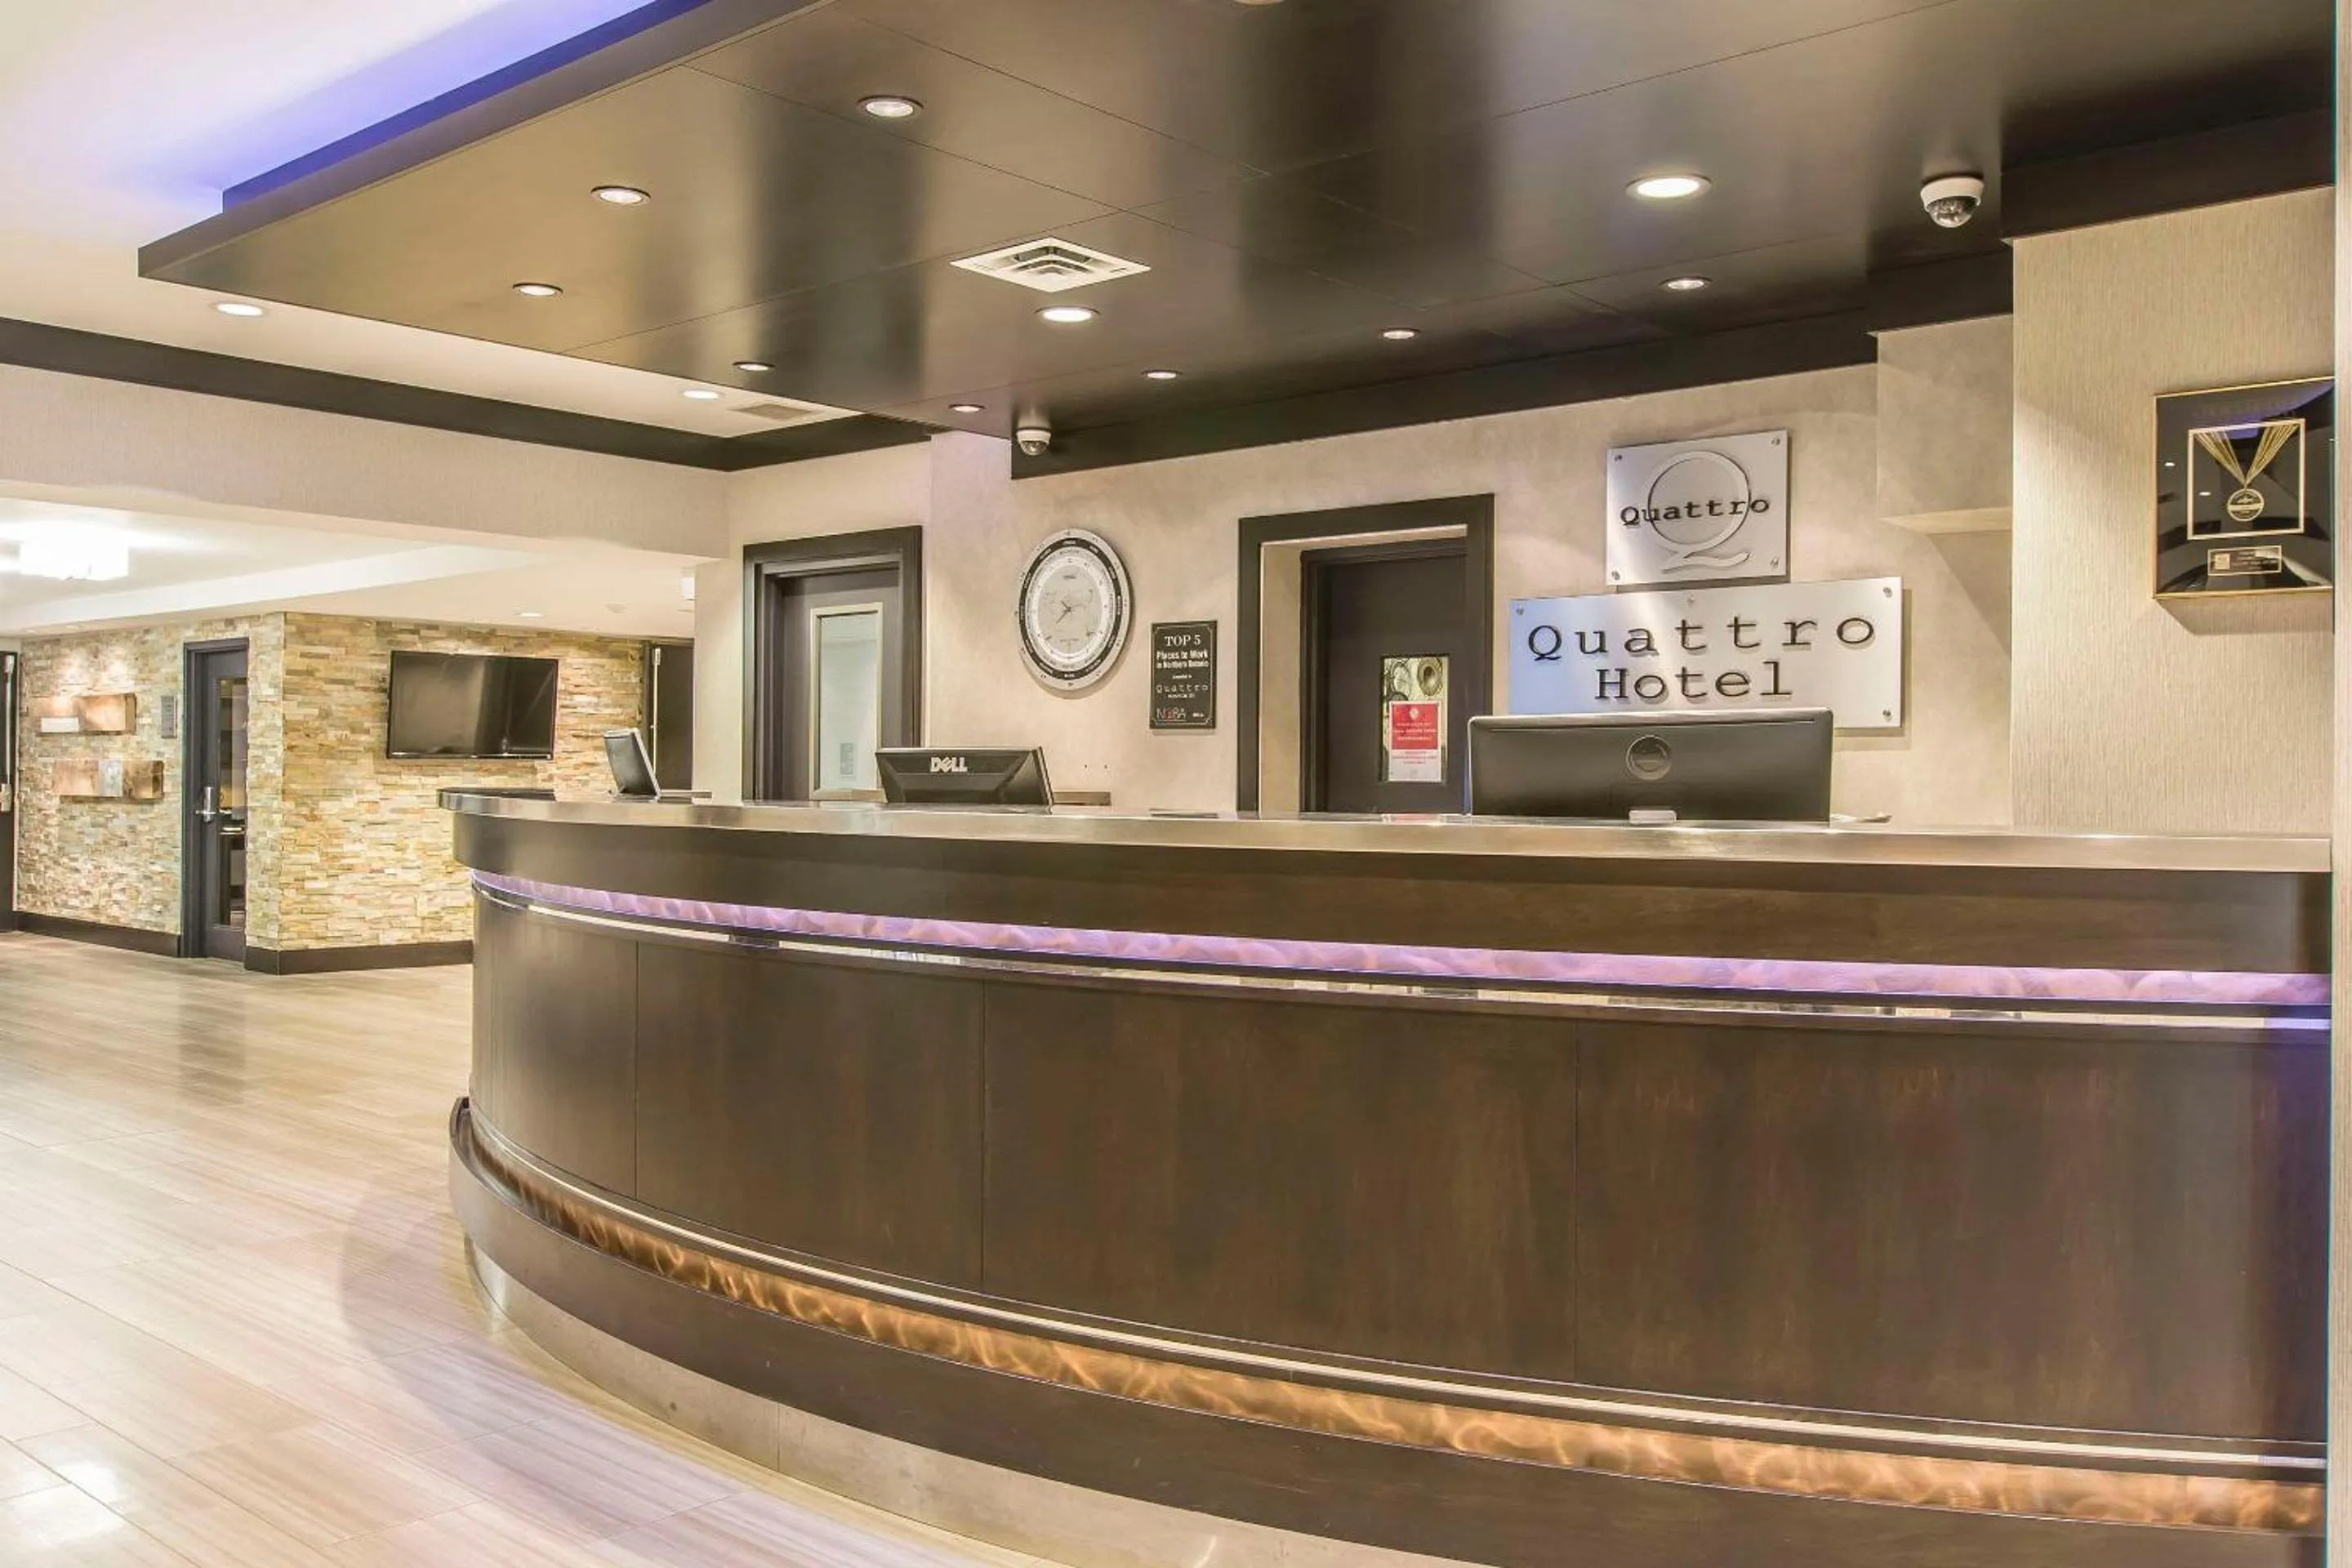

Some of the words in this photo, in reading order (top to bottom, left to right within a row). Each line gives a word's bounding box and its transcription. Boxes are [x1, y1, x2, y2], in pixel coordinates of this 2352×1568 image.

[1620, 497, 1770, 527] Quattro
[1165, 635, 1191, 647] TOP
[1194, 634, 1201, 645] 5
[1527, 614, 1876, 662] Quattro
[1594, 660, 1793, 702] Hotel
[929, 756, 968, 773] DELL
